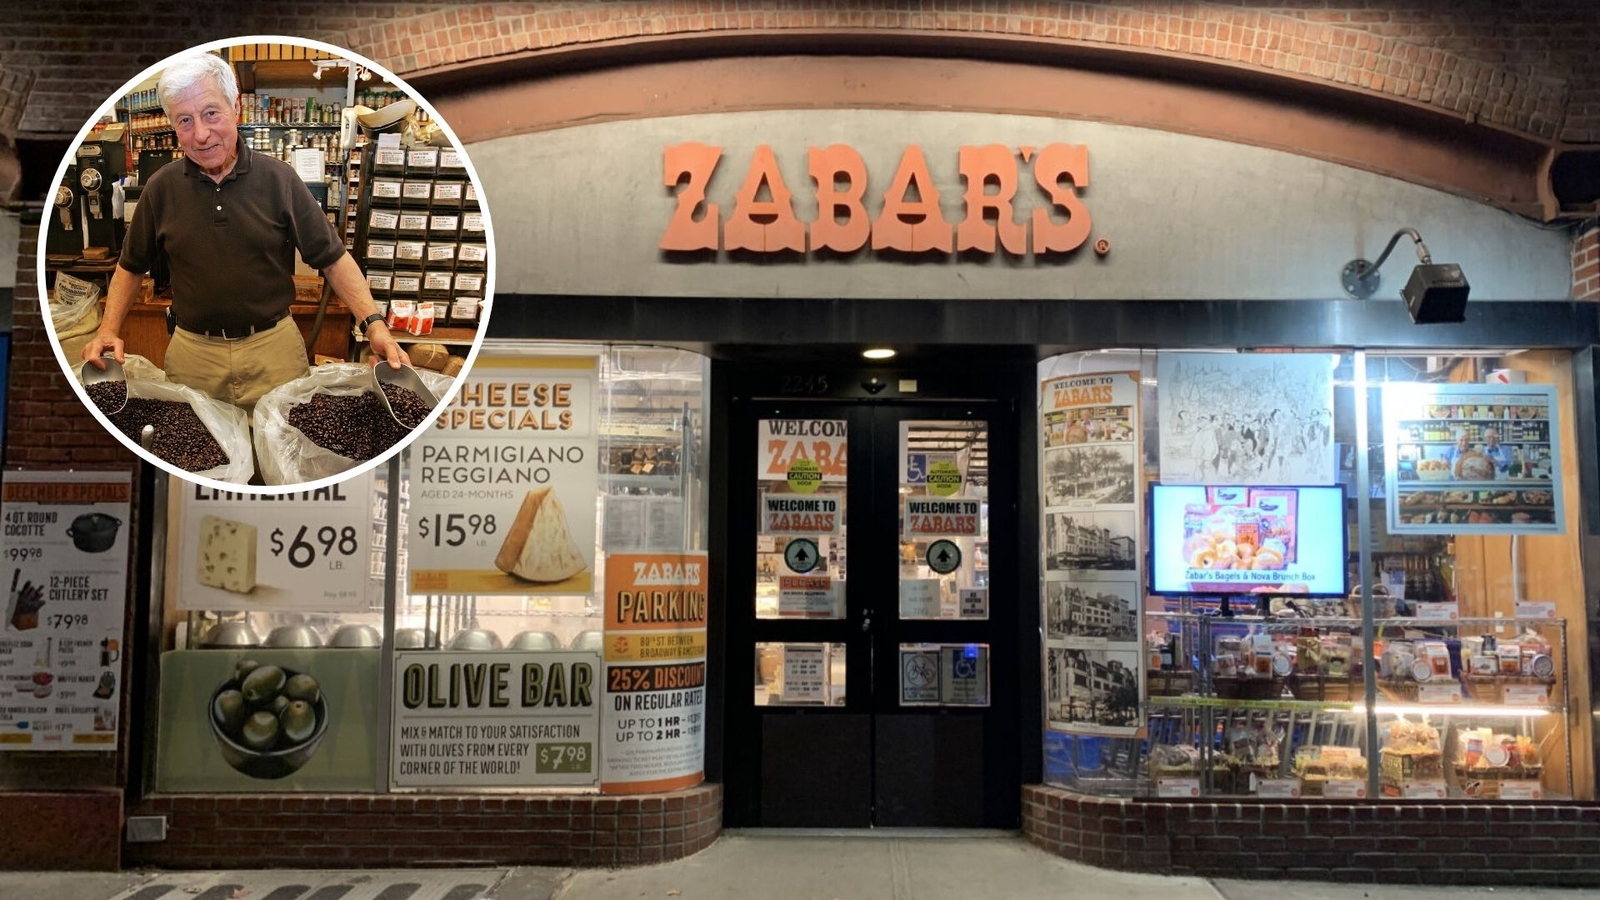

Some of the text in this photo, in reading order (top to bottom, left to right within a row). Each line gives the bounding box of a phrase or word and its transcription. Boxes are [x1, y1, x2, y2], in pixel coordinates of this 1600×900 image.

[659, 142, 1092, 255] ZABAR'S
[1053, 377, 1114, 390] WELCOME TO
[447, 382, 572, 407] HEESE
[436, 409, 573, 430] SPECIALS
[422, 446, 584, 464] PARMIGIANO
[421, 467, 551, 484] REGGIANO
[7, 485, 128, 500] DECEMBER SPECIALS
[421, 490, 450, 499] AGED
[768, 500, 836, 512] WELCOME TO
[909, 502, 977, 514] WELCOME TO
[5, 513, 12, 523] 4
[27, 512, 58, 523] ROUND
[5, 524, 45, 536] COCOTTE
[50, 576, 90, 589] 12-PIECE
[784, 577, 826, 588] PLEASE
[1185, 570, 1213, 580] Zabar's
[1215, 571, 1240, 582] Bagels
[1252, 572, 1270, 580] Nova
[1273, 571, 1299, 580] Brunch
[1302, 572, 1316, 580] Box
[49, 589, 108, 601] CUTLERY SET
[403, 662, 593, 709] OLIVE BAR
[611, 668, 651, 690] 25%
[614, 695, 632, 711] ON
[635, 692, 682, 711] REGULAR
[618, 719, 636, 729] UP
[638, 718, 655, 728] TO
[665, 716, 680, 727] HR
[401, 726, 419, 739] MIX
[429, 725, 462, 739] MATCH
[466, 726, 477, 739] TO
[481, 725, 506, 739] YOUR
[509, 725, 580, 739] SATISFACTION
[616, 732, 634, 742] UP
[637, 731, 653, 741] TO
[656, 730, 663, 740] 2
[665, 729, 680, 739] HR
[400, 743, 529, 757] WITH OLIVES FROM EVERY
[400, 761, 520, 775] CORNER OF THE WORLD!
